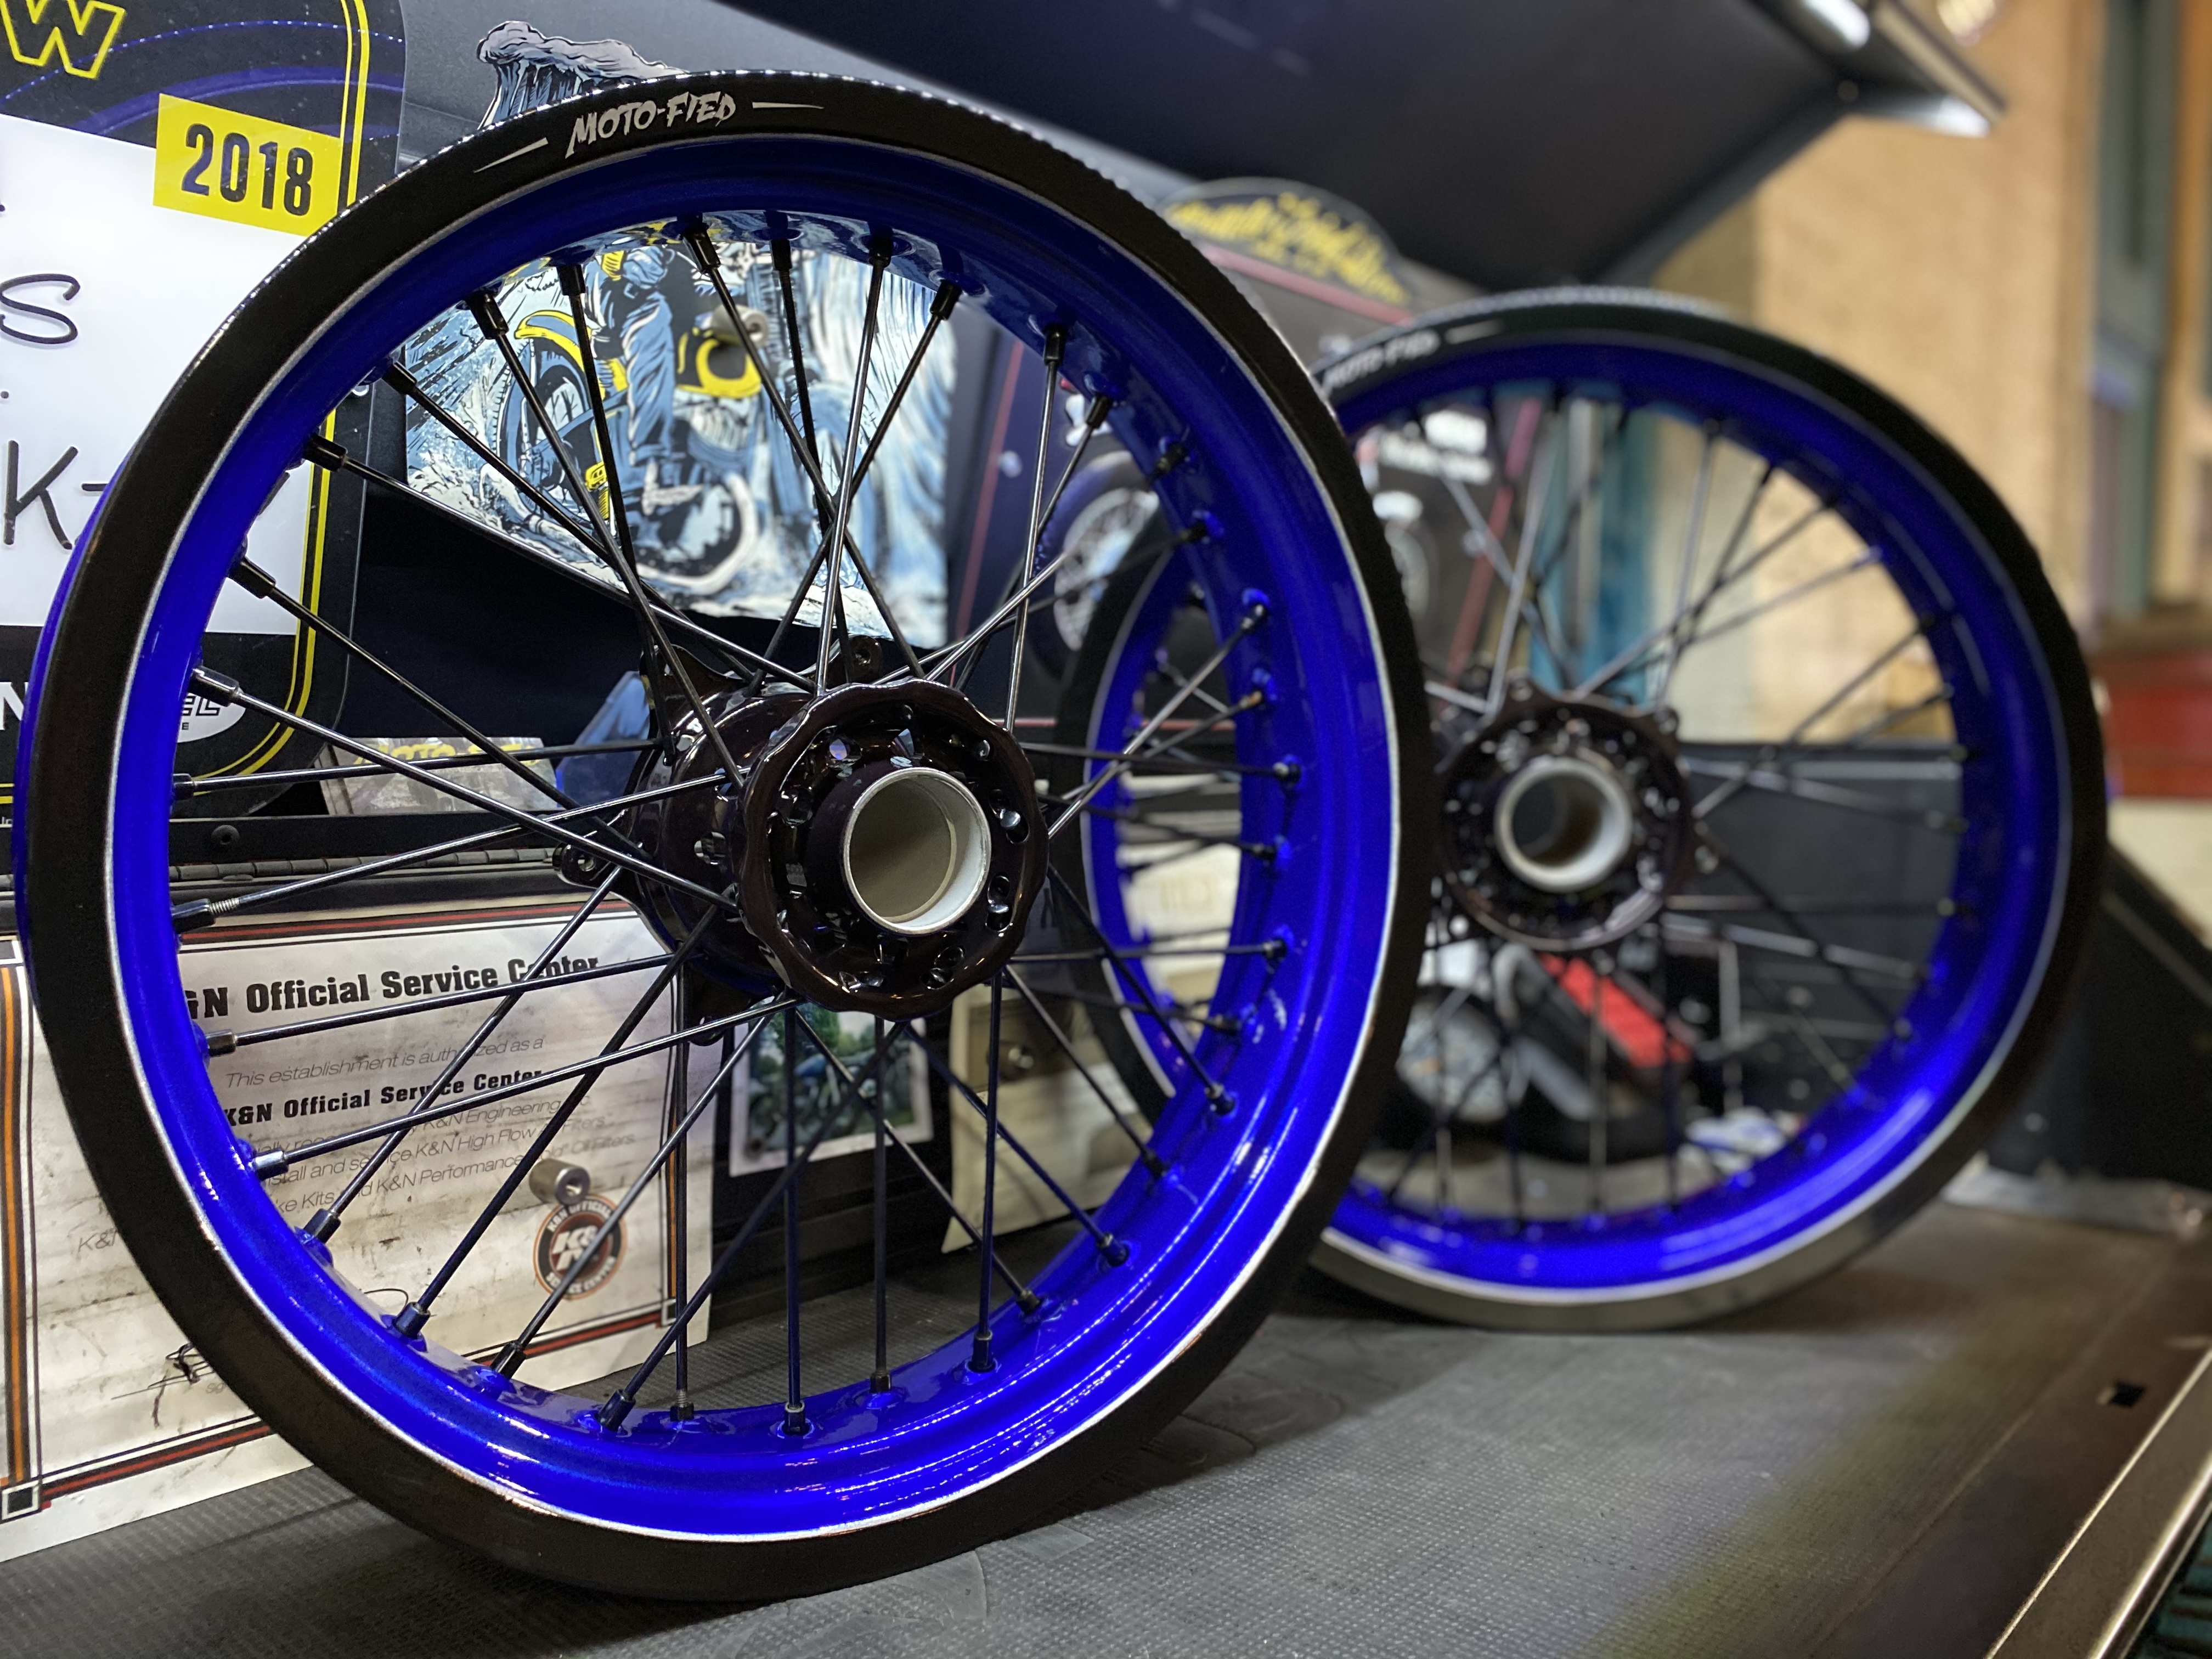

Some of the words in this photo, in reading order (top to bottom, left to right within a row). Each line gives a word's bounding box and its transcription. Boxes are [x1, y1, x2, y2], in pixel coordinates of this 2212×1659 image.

[565, 91, 736, 159] MOTO-FIED
[181, 123, 314, 216] 2018
[246, 974, 370, 1013] Official
[381, 964, 498, 999] Service
[226, 1072, 264, 1088] This
[269, 1053, 399, 1083] establishment
[402, 1052, 415, 1065] is
[419, 1040, 509, 1064] authzed
[510, 1040, 529, 1052] as
[533, 1037, 544, 1049] a
[224, 1103, 273, 1126] K&N
[284, 1089, 370, 1119] Official
[381, 1079, 465, 1104] Servce
[466, 1100, 562, 1124] Engineering
[310, 1158, 346, 1179] and
[349, 1149, 413, 1171] sece
[415, 1136, 455, 1159] K&N
[457, 1132, 494, 1152] High
[498, 1127, 537, 1144] Flow
[302, 1190, 335, 1209] Kits
[376, 1171, 417, 1193] K&N
[420, 1155, 524, 1184] Performance
